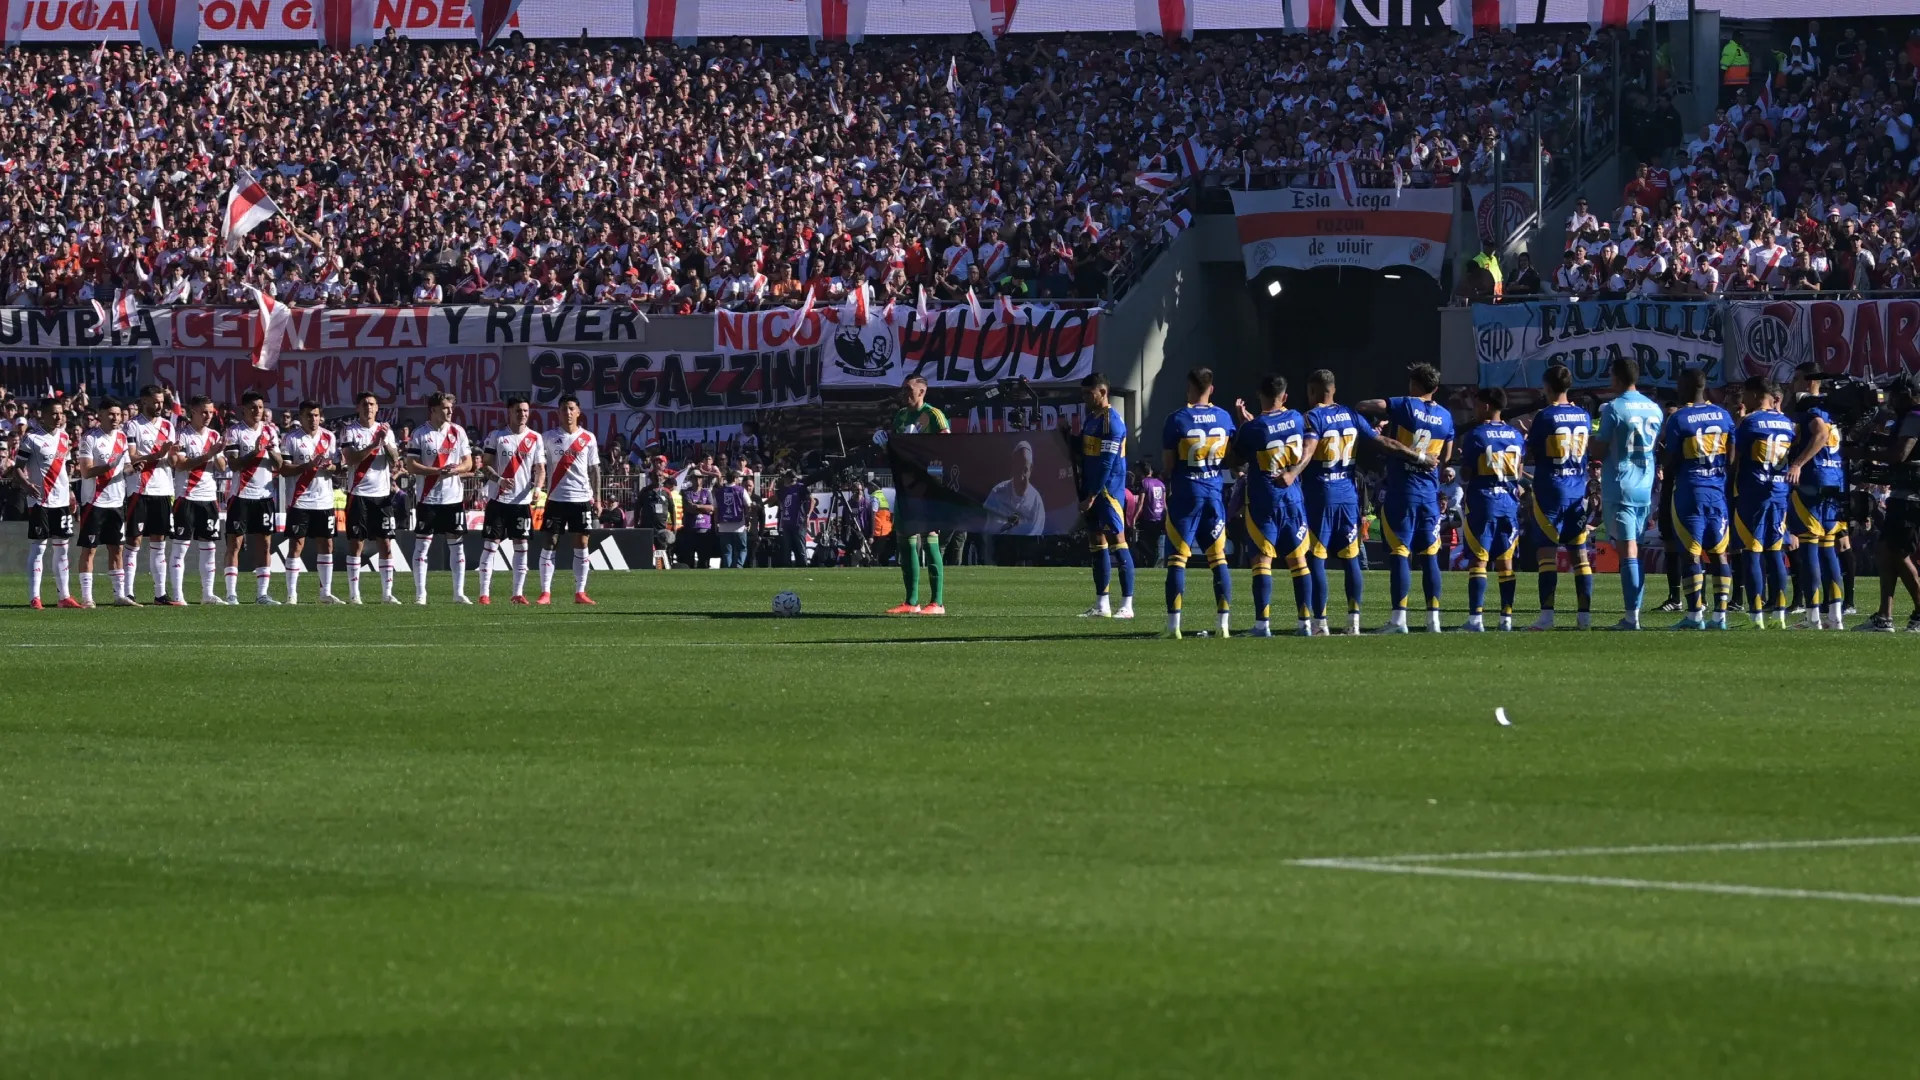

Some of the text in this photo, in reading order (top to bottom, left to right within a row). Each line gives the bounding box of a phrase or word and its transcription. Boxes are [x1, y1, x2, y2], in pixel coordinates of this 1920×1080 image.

[22, 0, 138, 30] UGA
[199, 0, 269, 29] ON
[1292, 190, 1331, 209] Esta
[1308, 238, 1374, 256] de vivir
[443, 307, 467, 344] Y
[486, 305, 638, 344] RIVER
[1536, 302, 1724, 347] FAMILIA
[717, 307, 1088, 382] NICO PALOMO
[1547, 342, 1718, 384] SUAREZ
[0, 355, 139, 397] ANDA DEL 45
[406, 352, 500, 406] ESTAR
[531, 345, 820, 409] SPEGAZZINI
[1193, 414, 1216, 423] ZENON
[1268, 420, 1296, 434] BLANCO
[1554, 414, 1587, 422] BELMONTE
[1687, 412, 1724, 423] ADVINCULA
[1487, 430, 1515, 438] DELGADO
[1187, 427, 1226, 467] 22
[1553, 426, 1589, 464] 30
[1763, 433, 1789, 471] 16
[61, 515, 74, 528] 22
[207, 518, 220, 532] 34
[456, 512, 464, 525] 11
[517, 517, 531, 530] 30
[582, 511, 592, 524] 15
